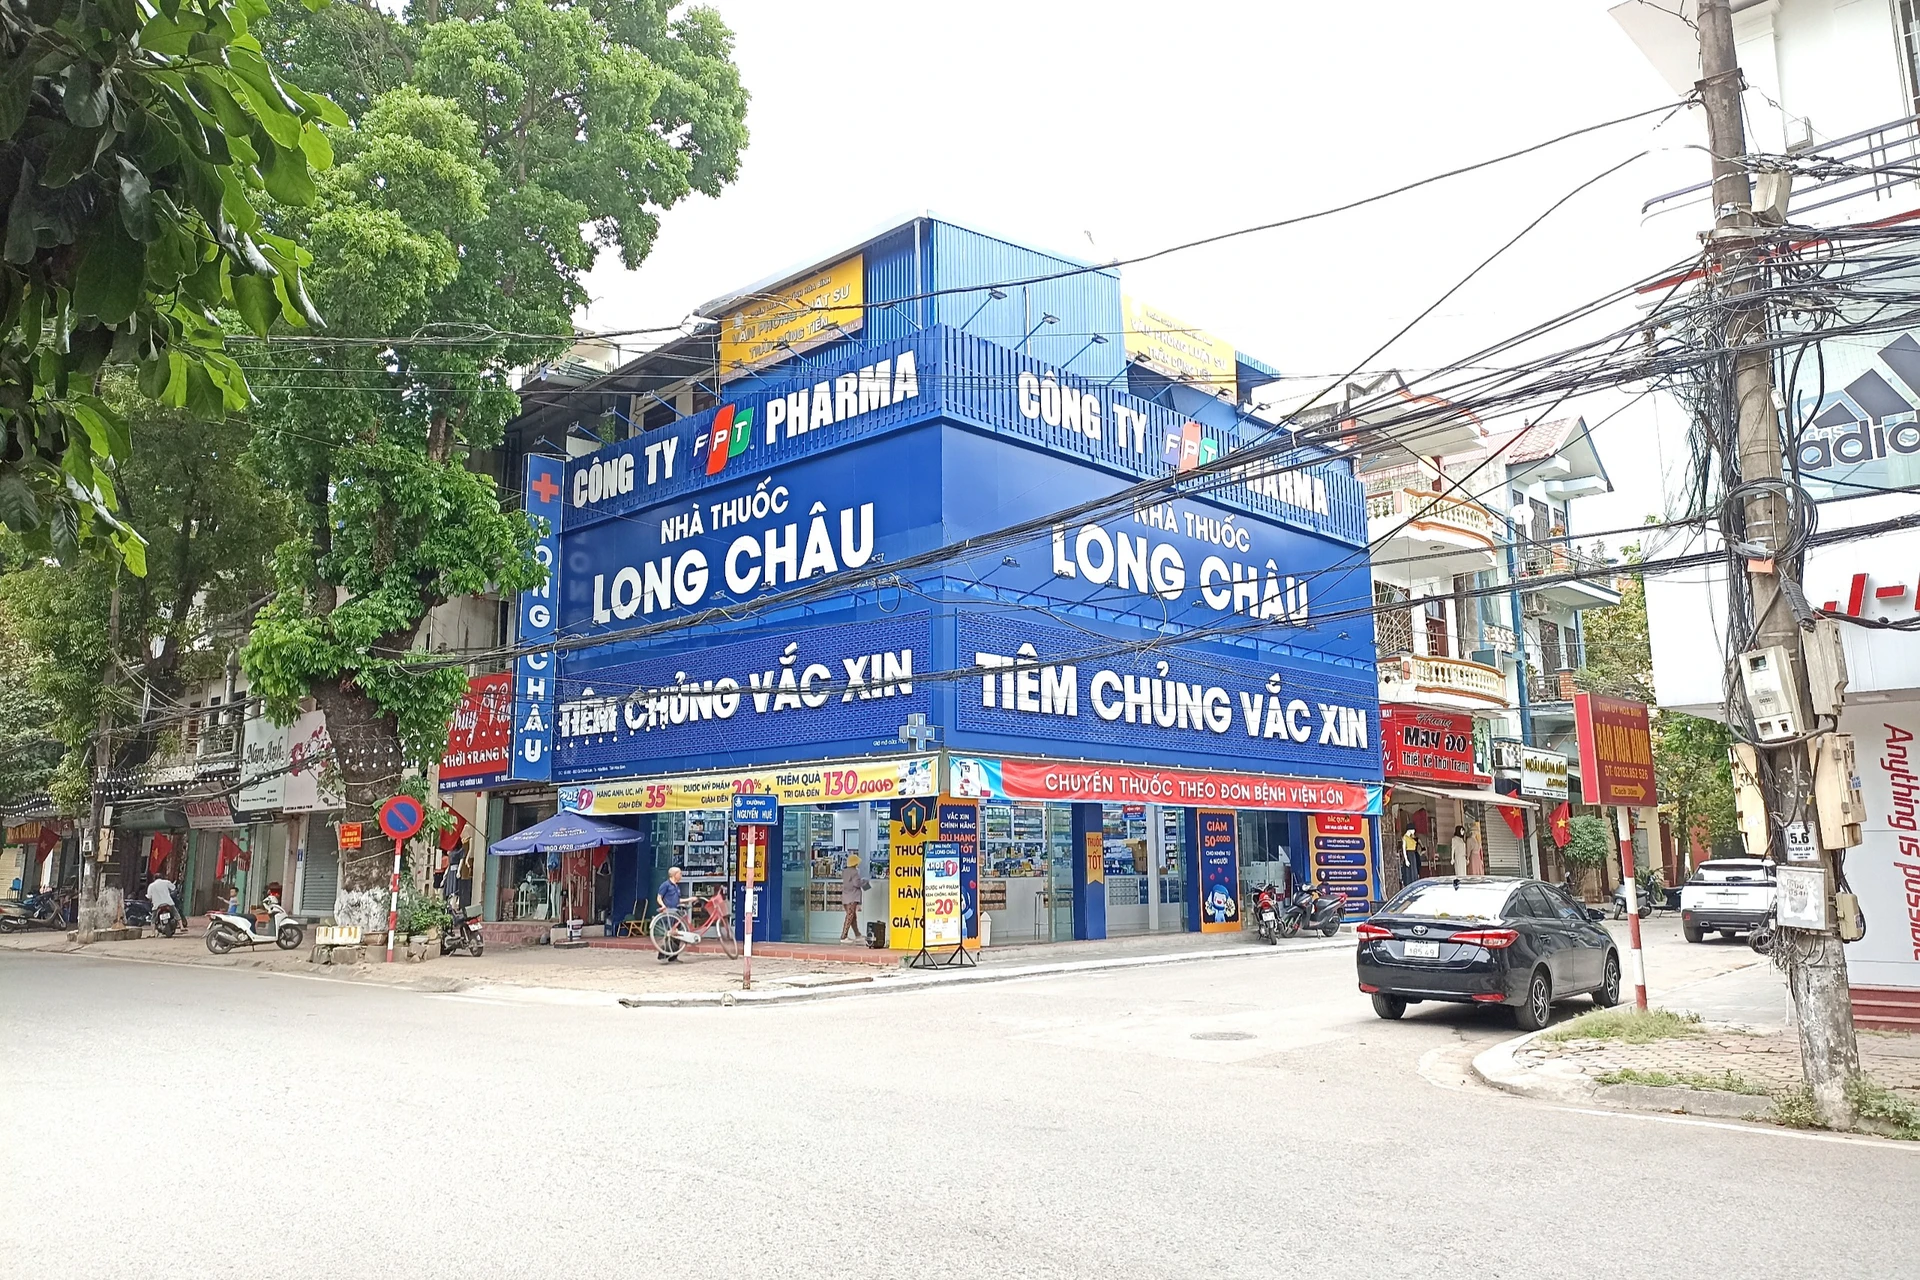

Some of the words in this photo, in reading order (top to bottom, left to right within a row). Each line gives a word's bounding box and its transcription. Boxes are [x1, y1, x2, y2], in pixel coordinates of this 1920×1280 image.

[1018, 368, 1102, 441] CÔNG
[1113, 406, 1149, 454] TY
[573, 456, 635, 508] CÔNG
[644, 436, 679, 485] TY
[766, 350, 920, 445] PHARMA
[660, 503, 704, 545] NHÀ
[711, 475, 790, 531] THUỐC
[1133, 497, 1179, 535] NHÀ
[1183, 514, 1251, 554] THUỐC
[593, 549, 710, 624] LONG
[724, 500, 876, 594] CHÂU
[1051, 521, 1186, 601] LONG
[1199, 554, 1310, 628] CHÂU
[558, 686, 618, 738] TIÊM
[623, 670, 741, 732] CHỦNG
[749, 641, 832, 714] VẮC
[841, 649, 914, 704] XIN
[975, 642, 1079, 717] TIÊM
[1090, 660, 1233, 734] CHỦNG
[1240, 672, 1313, 743] VẮC
[1317, 703, 1369, 750] XIN
[1404, 725, 1441, 750] MAY
[1595, 716, 1615, 762] BÁO
[1613, 719, 1632, 763] HÒA
[1630, 722, 1651, 766] BÌNH
[467, 747, 500, 766] TRANG
[1402, 751, 1420, 768] Thiết
[1450, 758, 1470, 774] Trang
[776, 771, 801, 786] THÊM
[801, 770, 821, 785] QUÀ
[823, 769, 894, 797] 130.000Đ
[1044, 771, 1114, 793] CHUYÊN
[1119, 772, 1174, 796] THUỐC
[1178, 780, 1217, 798] THEO
[1220, 783, 1251, 801] ĐƠN
[1254, 782, 1287, 806] BỆNH
[1289, 785, 1318, 808] VIỆN
[1320, 786, 1345, 805] LỚN
[645, 784, 673, 809] 35%
[806, 787, 820, 798] ĐẾN
[736, 807, 759, 819] NGUYỄN
[908, 806, 917, 831] 1
[940, 820, 959, 830] CHÍNH
[959, 820, 976, 830] HÃNG
[946, 811, 959, 820] VẮC
[1206, 818, 1228, 832] GIẢM
[953, 831, 976, 843] HÀNG
[1790, 832, 1811, 845] 5.6
[1088, 849, 1102, 870] TỐT
[935, 898, 959, 915] 20%
[892, 914, 911, 928] GIÁ
